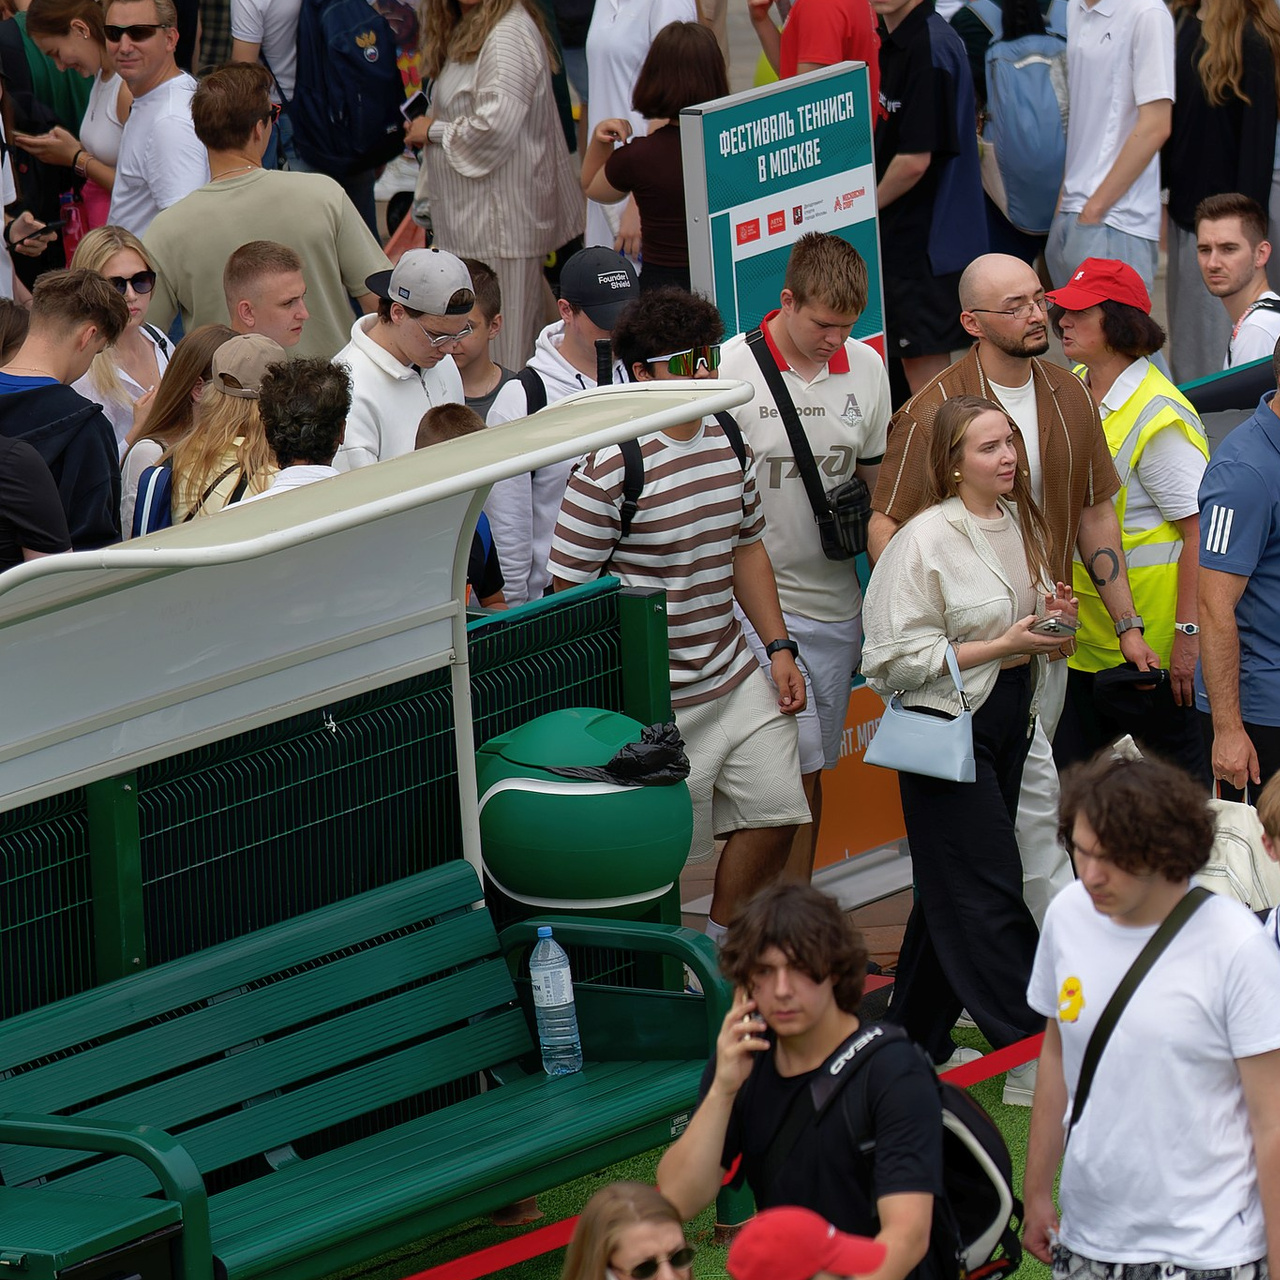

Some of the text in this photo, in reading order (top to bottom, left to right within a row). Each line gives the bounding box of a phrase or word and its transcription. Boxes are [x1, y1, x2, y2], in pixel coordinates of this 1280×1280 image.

[719, 111, 795, 157] ФЕСТИВАЛЬ
[797, 91, 855, 133] ТЕННИСА
[758, 138, 822, 183] В МОСКВЕ
[598, 273, 626, 285] Founder
[611, 281, 631, 290] Shield
[759, 406, 826, 419] Beoom
